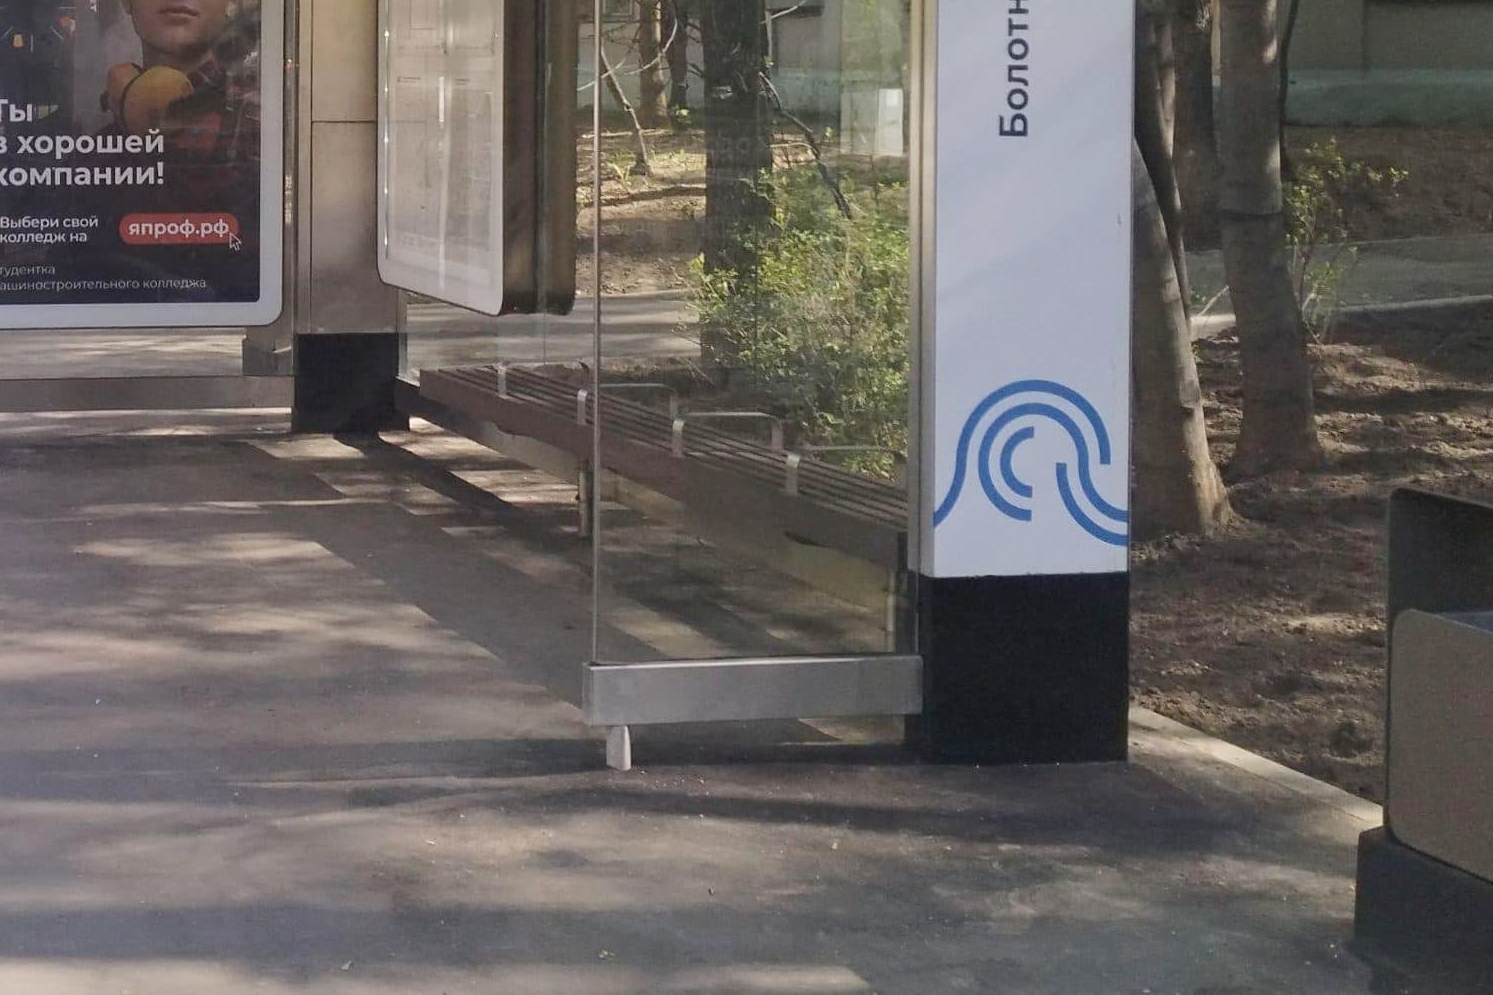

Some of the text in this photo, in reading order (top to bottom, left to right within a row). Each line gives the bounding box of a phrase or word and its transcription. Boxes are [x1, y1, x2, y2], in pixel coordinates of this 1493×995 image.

[16, 129, 164, 159] хорошей
[0, 215, 99, 232] Выбери свой
[128, 218, 230, 238] япроф.рф
[0, 231, 88, 244] колледж на
[142, 278, 207, 290] колледжа
